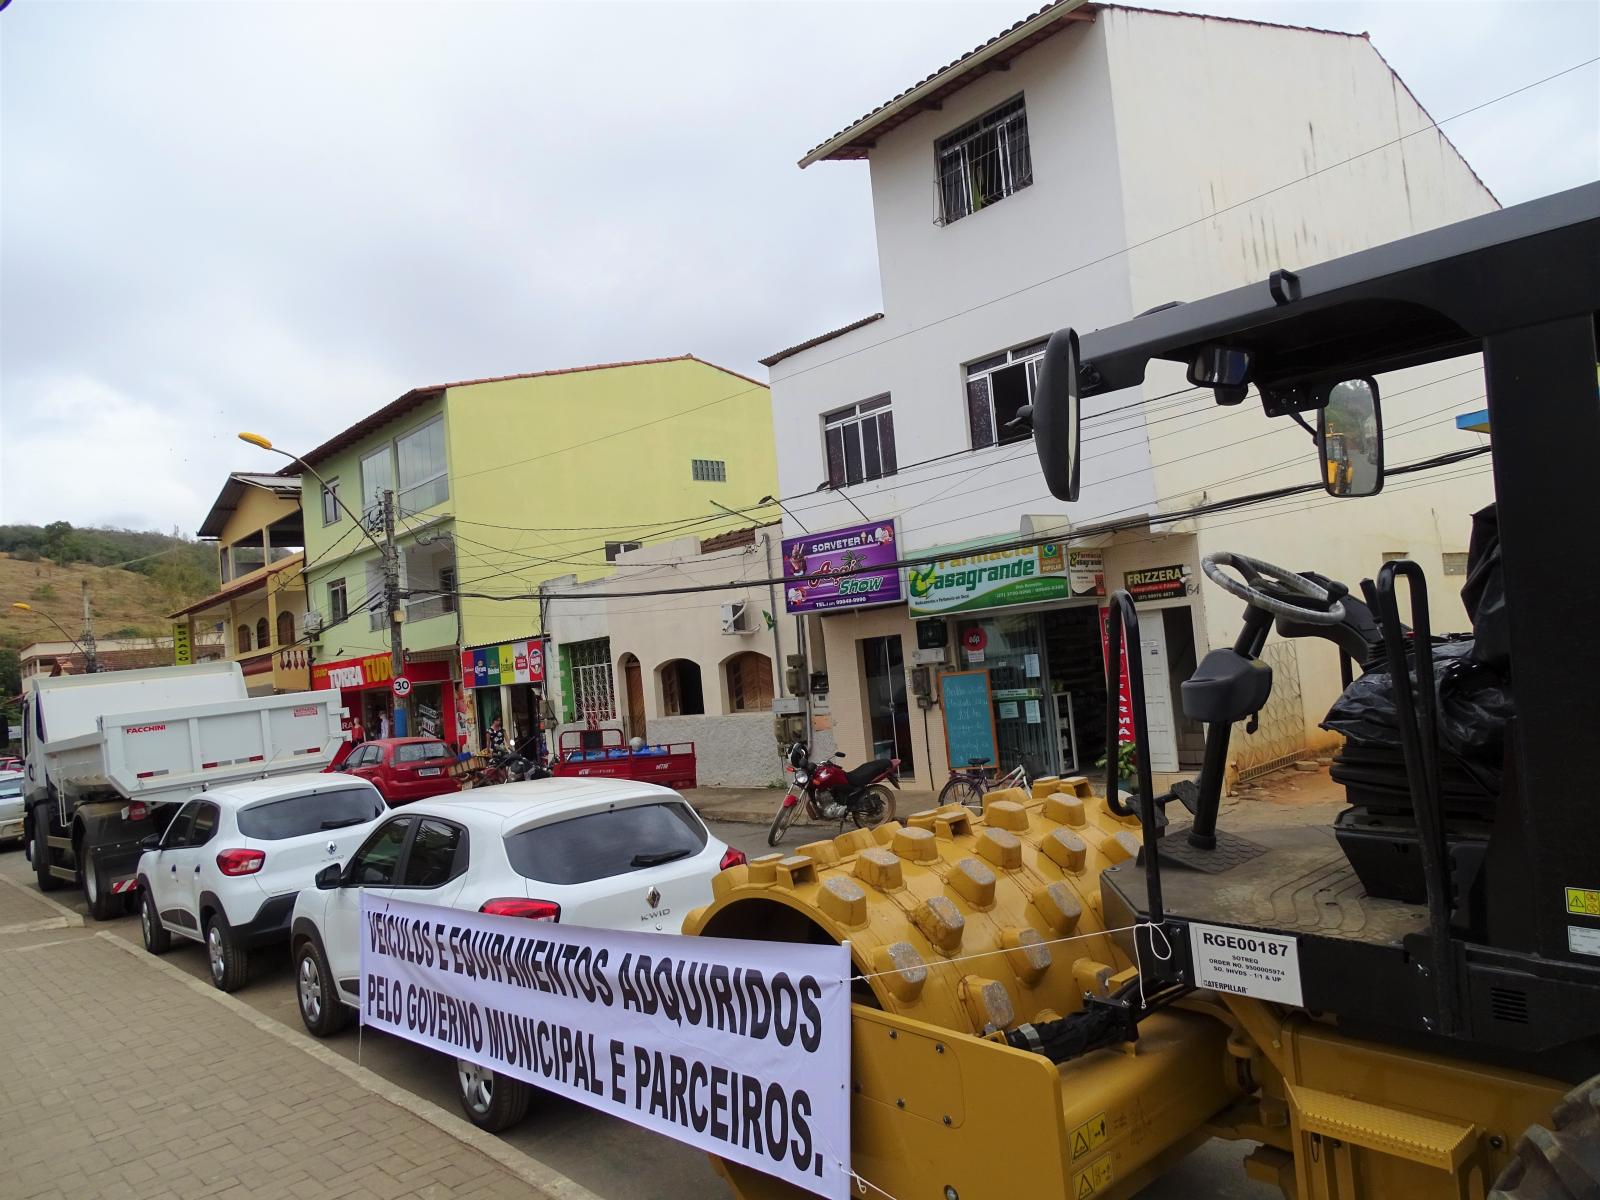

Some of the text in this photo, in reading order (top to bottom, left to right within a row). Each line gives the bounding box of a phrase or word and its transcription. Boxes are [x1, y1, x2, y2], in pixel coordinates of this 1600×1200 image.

[1127, 568, 1182, 585] FRIZZERA
[839, 577, 883, 595] Show
[328, 665, 364, 689] TORRA
[394, 681, 410, 691] 30
[126, 724, 166, 736] FACCHINI
[640, 908, 671, 921] KWID
[1203, 932, 1288, 957] RGE00187
[1209, 958, 1231, 967] ORDER
[1232, 955, 1259, 964] SOTREQ
[367, 903, 822, 1053] VEÍCULOS E EQUIPAMENTOS ADQUIRIDOS
[1203, 980, 1247, 994] CATERPILLAR
[367, 974, 824, 1178] PELO GOVERNO MUNICIPAL E PARCEIROS.
